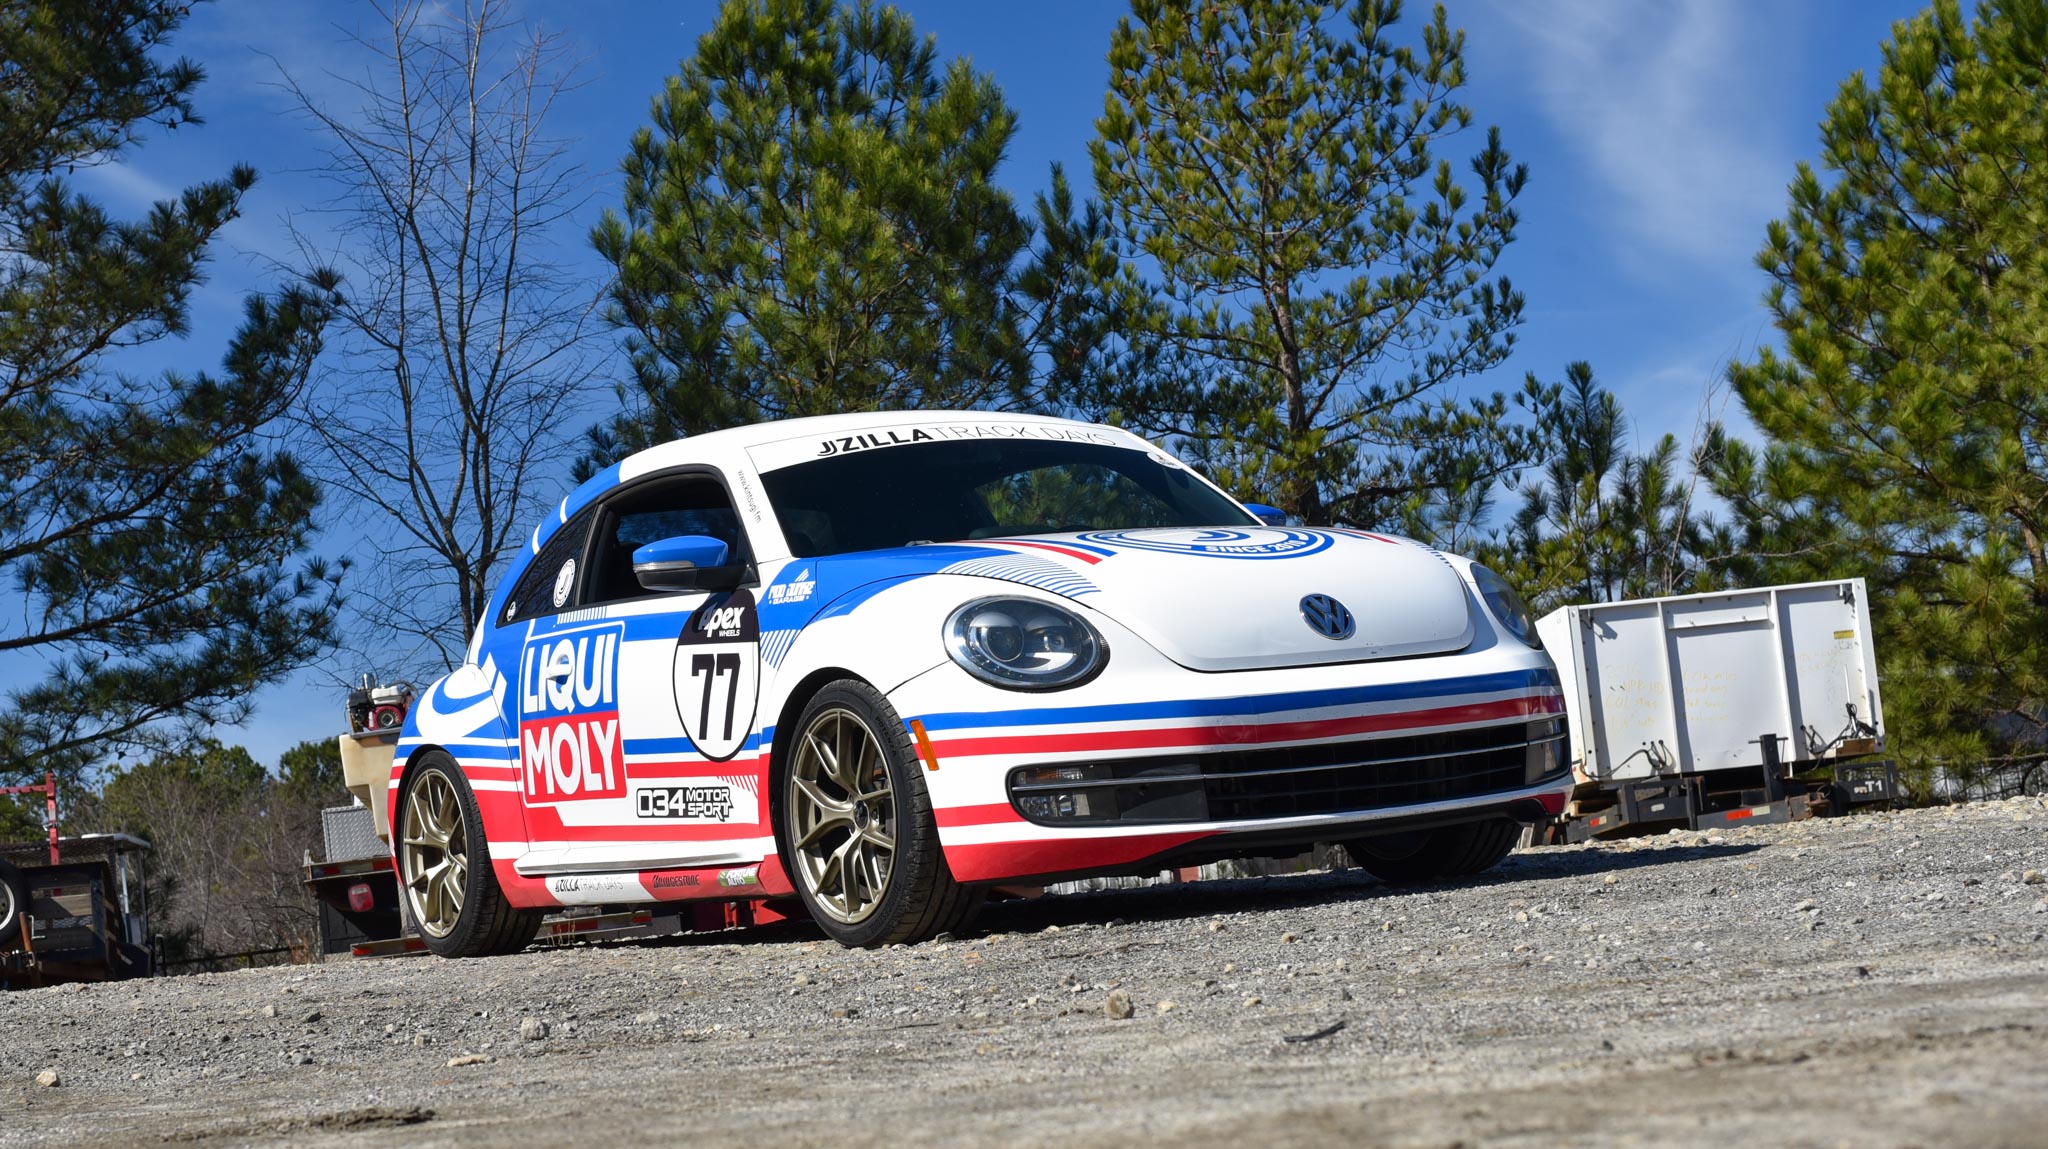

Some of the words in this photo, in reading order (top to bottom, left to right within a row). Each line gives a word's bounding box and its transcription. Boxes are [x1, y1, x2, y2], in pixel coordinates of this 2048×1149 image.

[935, 425, 1038, 440] TRACK
[1039, 426, 1117, 446] DAYS
[1205, 545, 1271, 553] SINCE
[772, 595, 805, 605] GARAGE
[718, 629, 741, 637] WHEELS
[523, 633, 617, 714] LIQUI
[691, 652, 741, 741] 77
[875, 715, 897, 758] POTENZA
[524, 718, 619, 796] MOLY
[1864, 780, 1883, 792] T1
[637, 789, 686, 816] 034
[686, 788, 730, 801] MOTOR
[687, 802, 731, 821] SPORT
[652, 875, 700, 888] BRIDGESTONE
